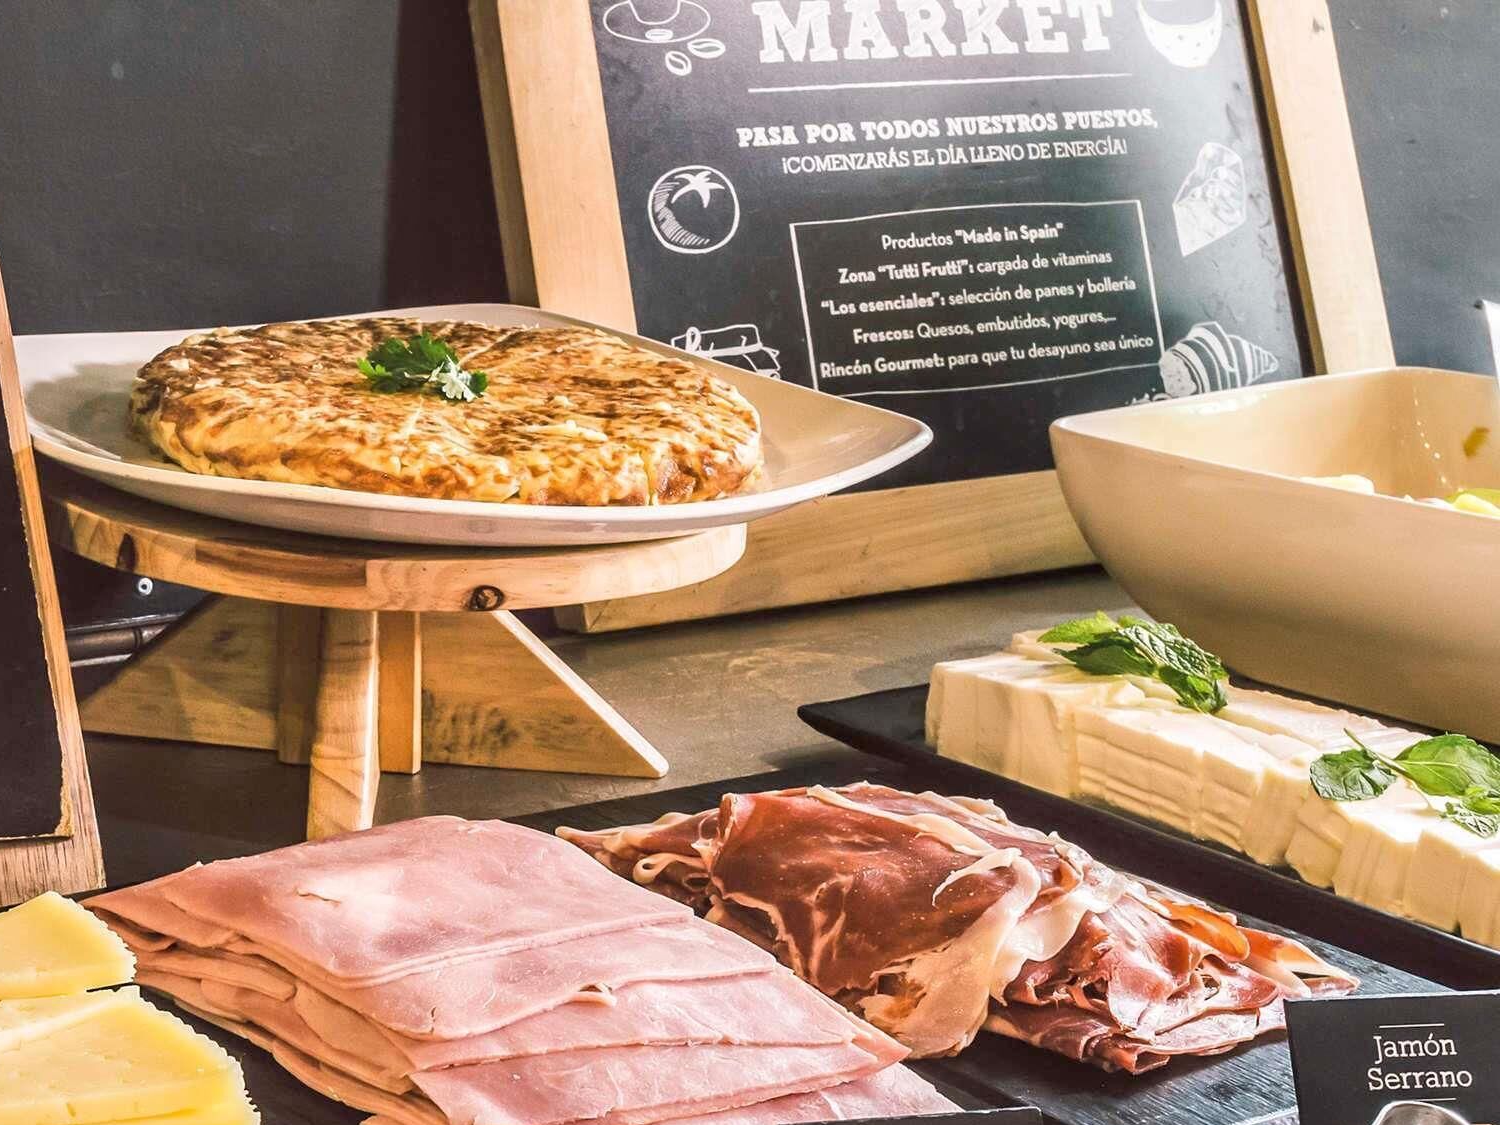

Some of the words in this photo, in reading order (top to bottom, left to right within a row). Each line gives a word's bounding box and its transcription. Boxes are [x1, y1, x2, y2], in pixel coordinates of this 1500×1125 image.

[752, 0, 1114, 63] MARKET
[736, 125, 799, 148] PASA
[805, 122, 856, 144] POR
[860, 118, 940, 141] TODOS
[945, 113, 1059, 137] NUESTROS
[1064, 108, 1158, 131] PUESTOS,
[913, 149, 935, 167] EL
[937, 144, 969, 166] DÍA
[969, 143, 1025, 164] LLENO
[1028, 142, 1052, 160] DE
[881, 232, 953, 250] Productos
[1004, 226, 1018, 242] in
[838, 267, 876, 284] Zona
[977, 255, 1028, 275] cargada
[1032, 252, 1049, 268] de
[1052, 250, 1113, 267] vitaminas
[948, 285, 1012, 305] selección
[1014, 284, 1032, 300] de
[1035, 285, 1074, 302] panes
[1076, 284, 1085, 298] y
[1087, 275, 1136, 294] bollería
[853, 327, 914, 345] Frescos:
[917, 322, 974, 339] Quesos,
[977, 312, 1050, 333] embutidos,
[820, 360, 872, 378] Rincón
[874, 353, 944, 373] Gourmet:
[947, 354, 978, 371] para
[981, 350, 1008, 367] que
[1010, 346, 1026, 361] tu
[1028, 342, 1091, 359] desayuno
[1093, 339, 1116, 352] sea
[1119, 334, 1154, 350] único
[1373, 1032, 1457, 1065] Jamón
[1367, 1067, 1473, 1091] Serrano
